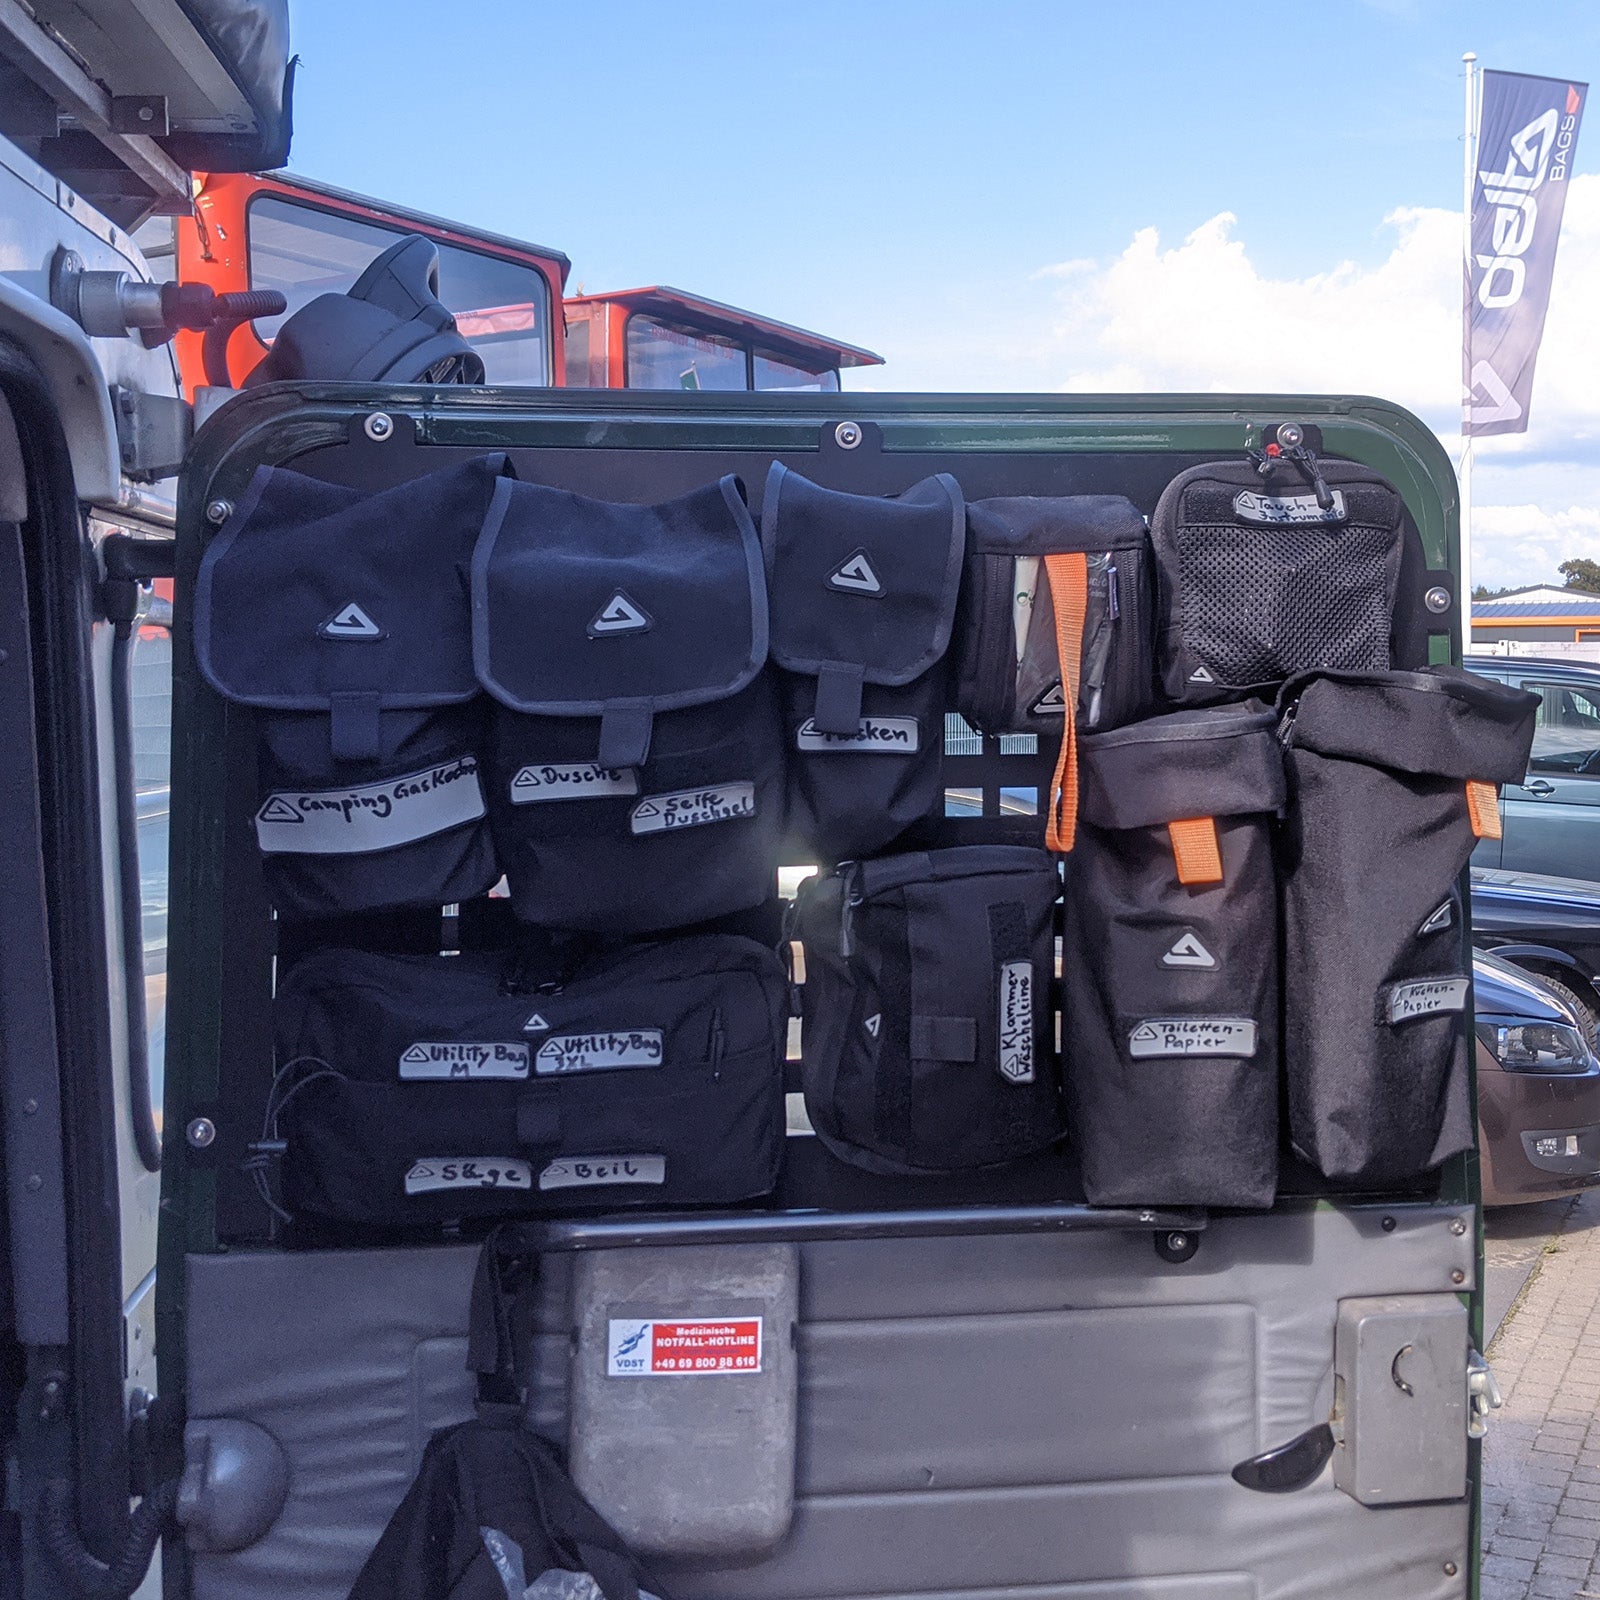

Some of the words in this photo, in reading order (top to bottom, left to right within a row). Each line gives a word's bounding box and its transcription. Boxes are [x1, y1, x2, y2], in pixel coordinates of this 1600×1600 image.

[1550, 115, 1575, 182] BAGS
[1255, 497, 1317, 511] Tauch-
[540, 766, 623, 785] Dusche
[665, 792, 725, 813] Seife
[1002, 968, 1019, 1051] Klammer
[1403, 997, 1441, 1014] Papier
[1158, 1023, 1244, 1035] Toiletten-
[1164, 1034, 1226, 1053] Papier
[430, 1045, 490, 1068] Utility
[493, 1045, 528, 1071] Bag
[450, 1063, 470, 1078] M
[441, 1163, 522, 1187] Säge
[574, 1161, 639, 1179] Beil
[675, 1326, 736, 1336] Medizinische
[656, 1336, 755, 1347] NOTFALL-HOTLINE
[616, 1359, 645, 1368] VDST
[655, 1358, 676, 1369] +49
[678, 1358, 693, 1368] 69
[695, 1357, 717, 1368] 800
[735, 1356, 756, 1367] 616
